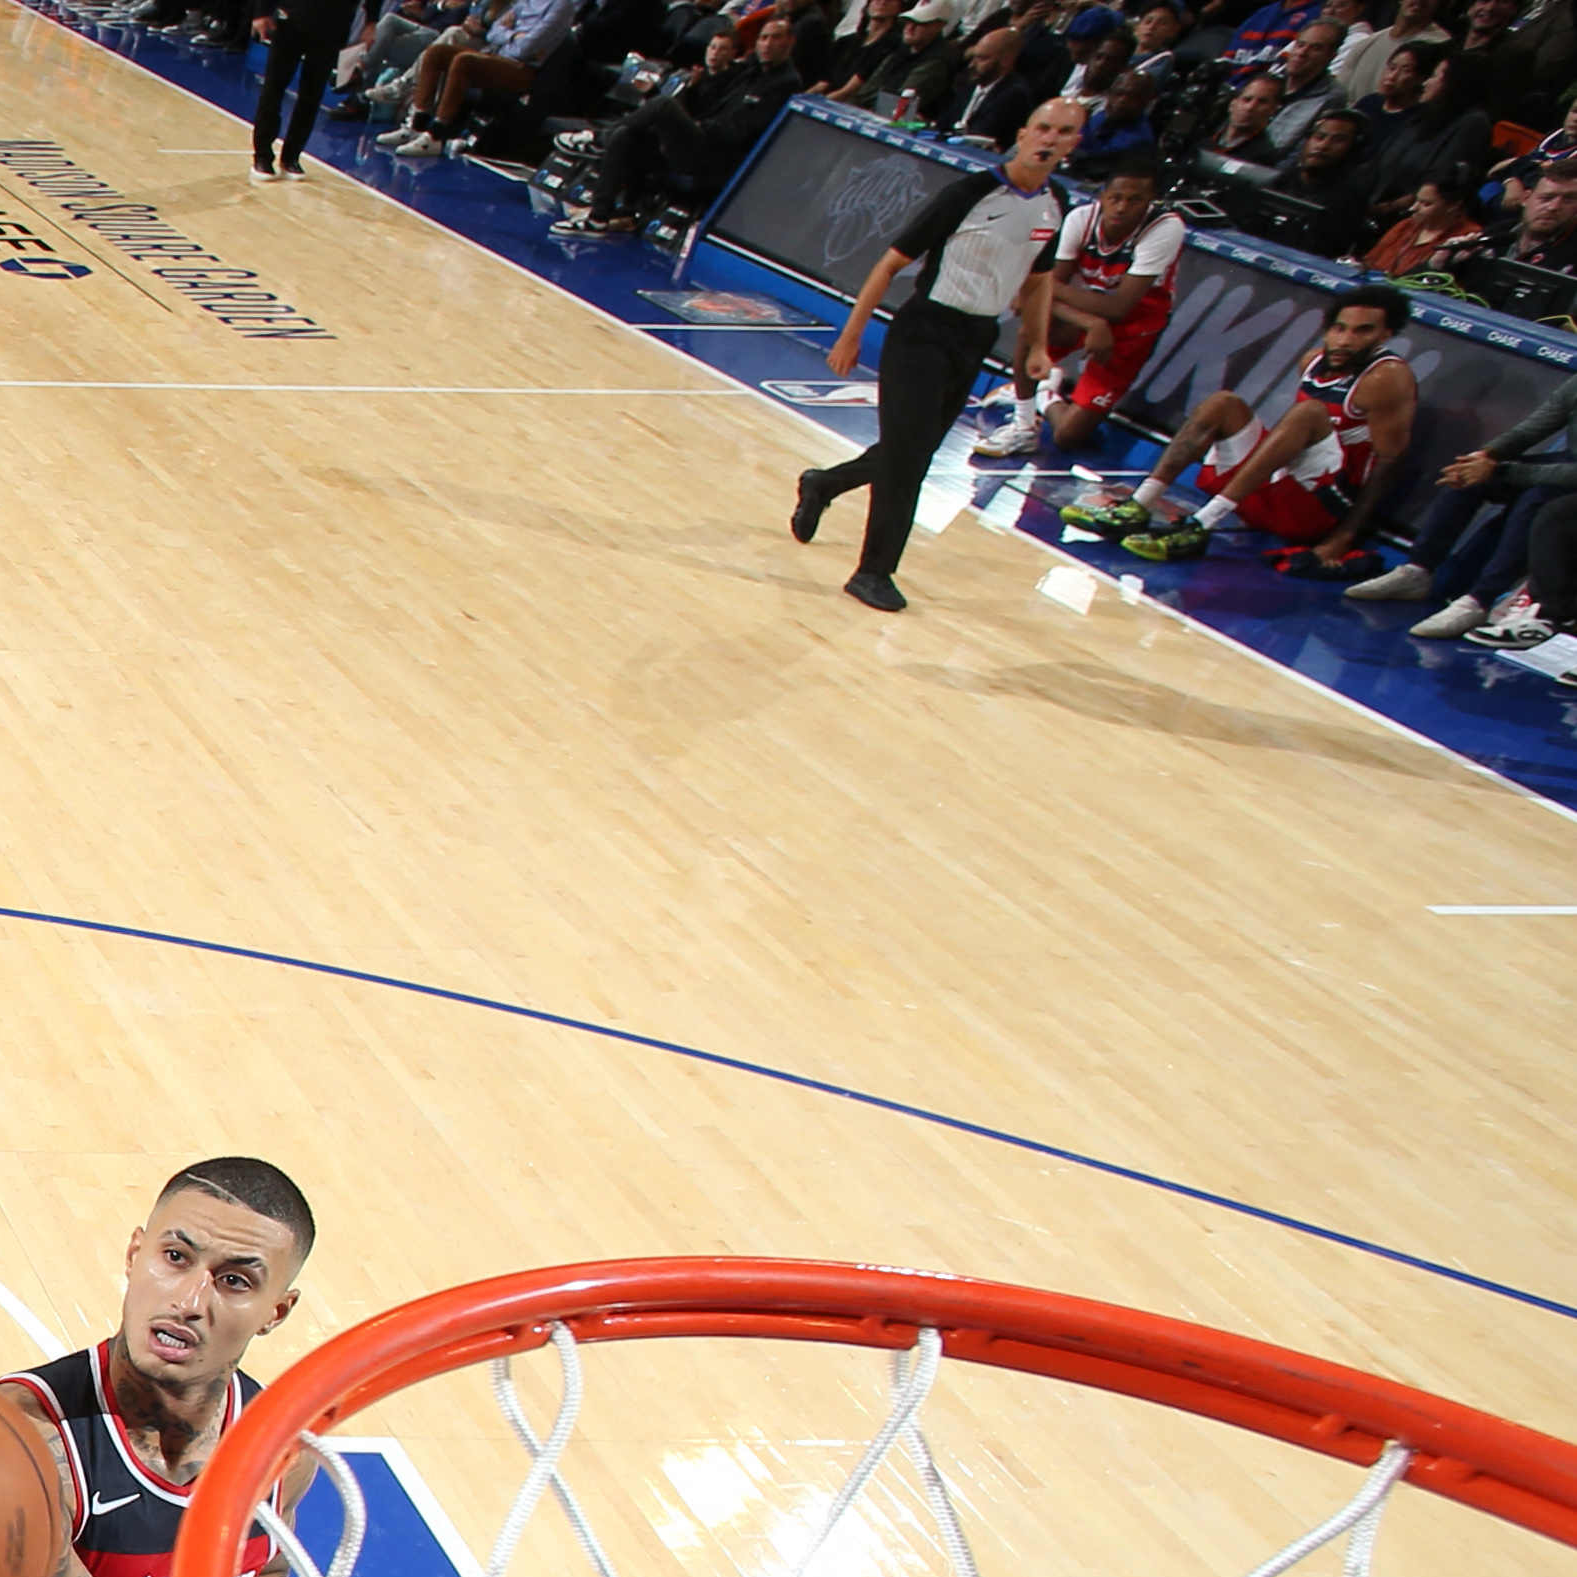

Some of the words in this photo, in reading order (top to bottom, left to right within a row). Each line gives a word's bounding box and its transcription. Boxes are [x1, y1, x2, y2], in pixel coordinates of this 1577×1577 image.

[60, 203, 221, 261] SQUARE
[152, 267, 339, 339] GARDEN
[1439, 317, 1473, 333] CHASE
[1488, 331, 1523, 348] CHASE
[1537, 346, 1574, 364] CHASE
